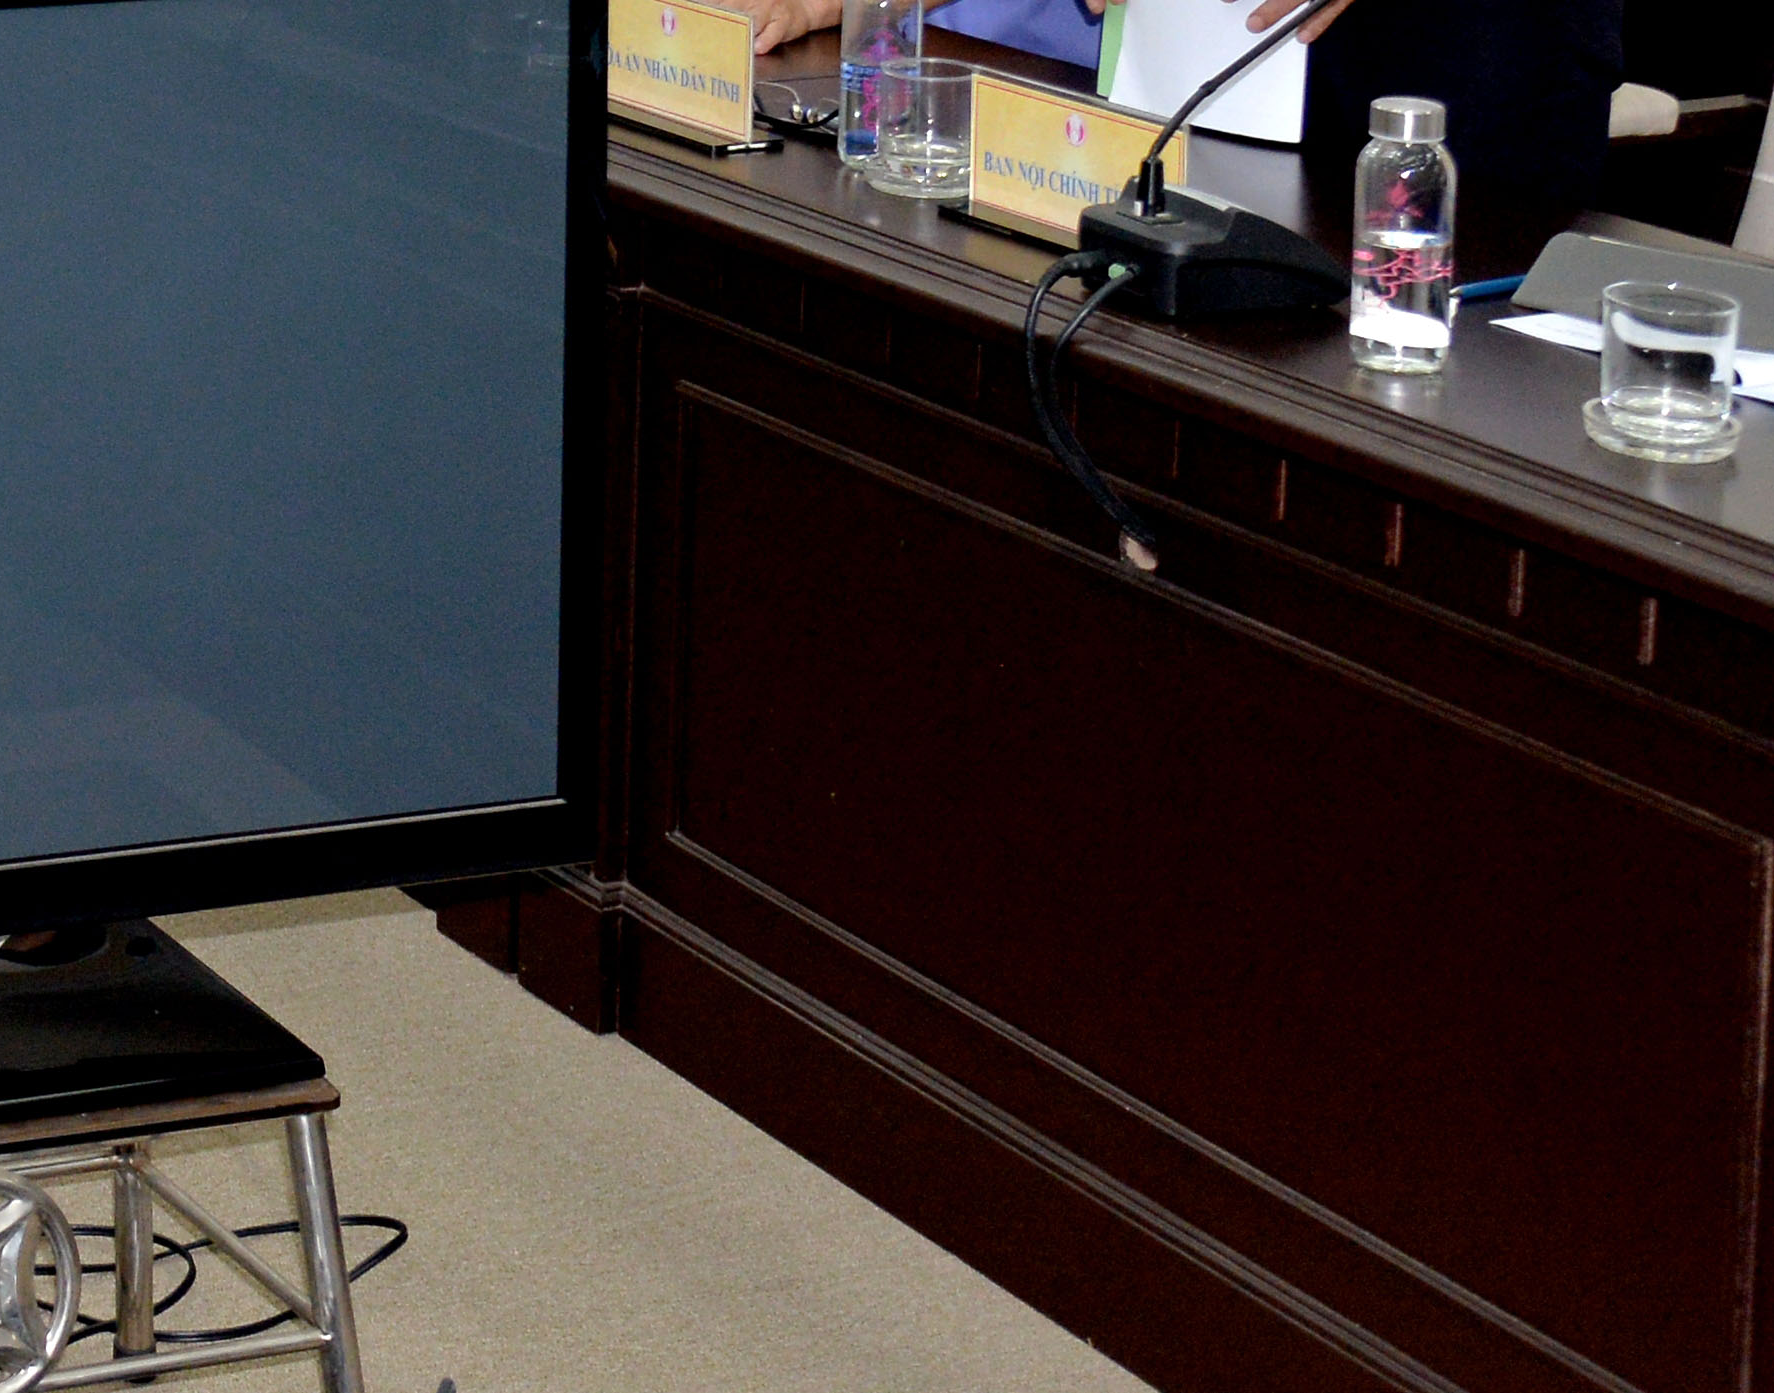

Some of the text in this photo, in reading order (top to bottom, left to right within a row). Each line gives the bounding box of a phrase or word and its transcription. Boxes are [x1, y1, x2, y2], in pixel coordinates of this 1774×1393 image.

[643, 57, 678, 85] NHÂN
[680, 65, 707, 92] DÂN
[709, 73, 741, 104] TỈNH
[984, 151, 1014, 178] BAN
[1018, 160, 1045, 191] NỘI
[1048, 170, 1099, 206] CHÍNH
